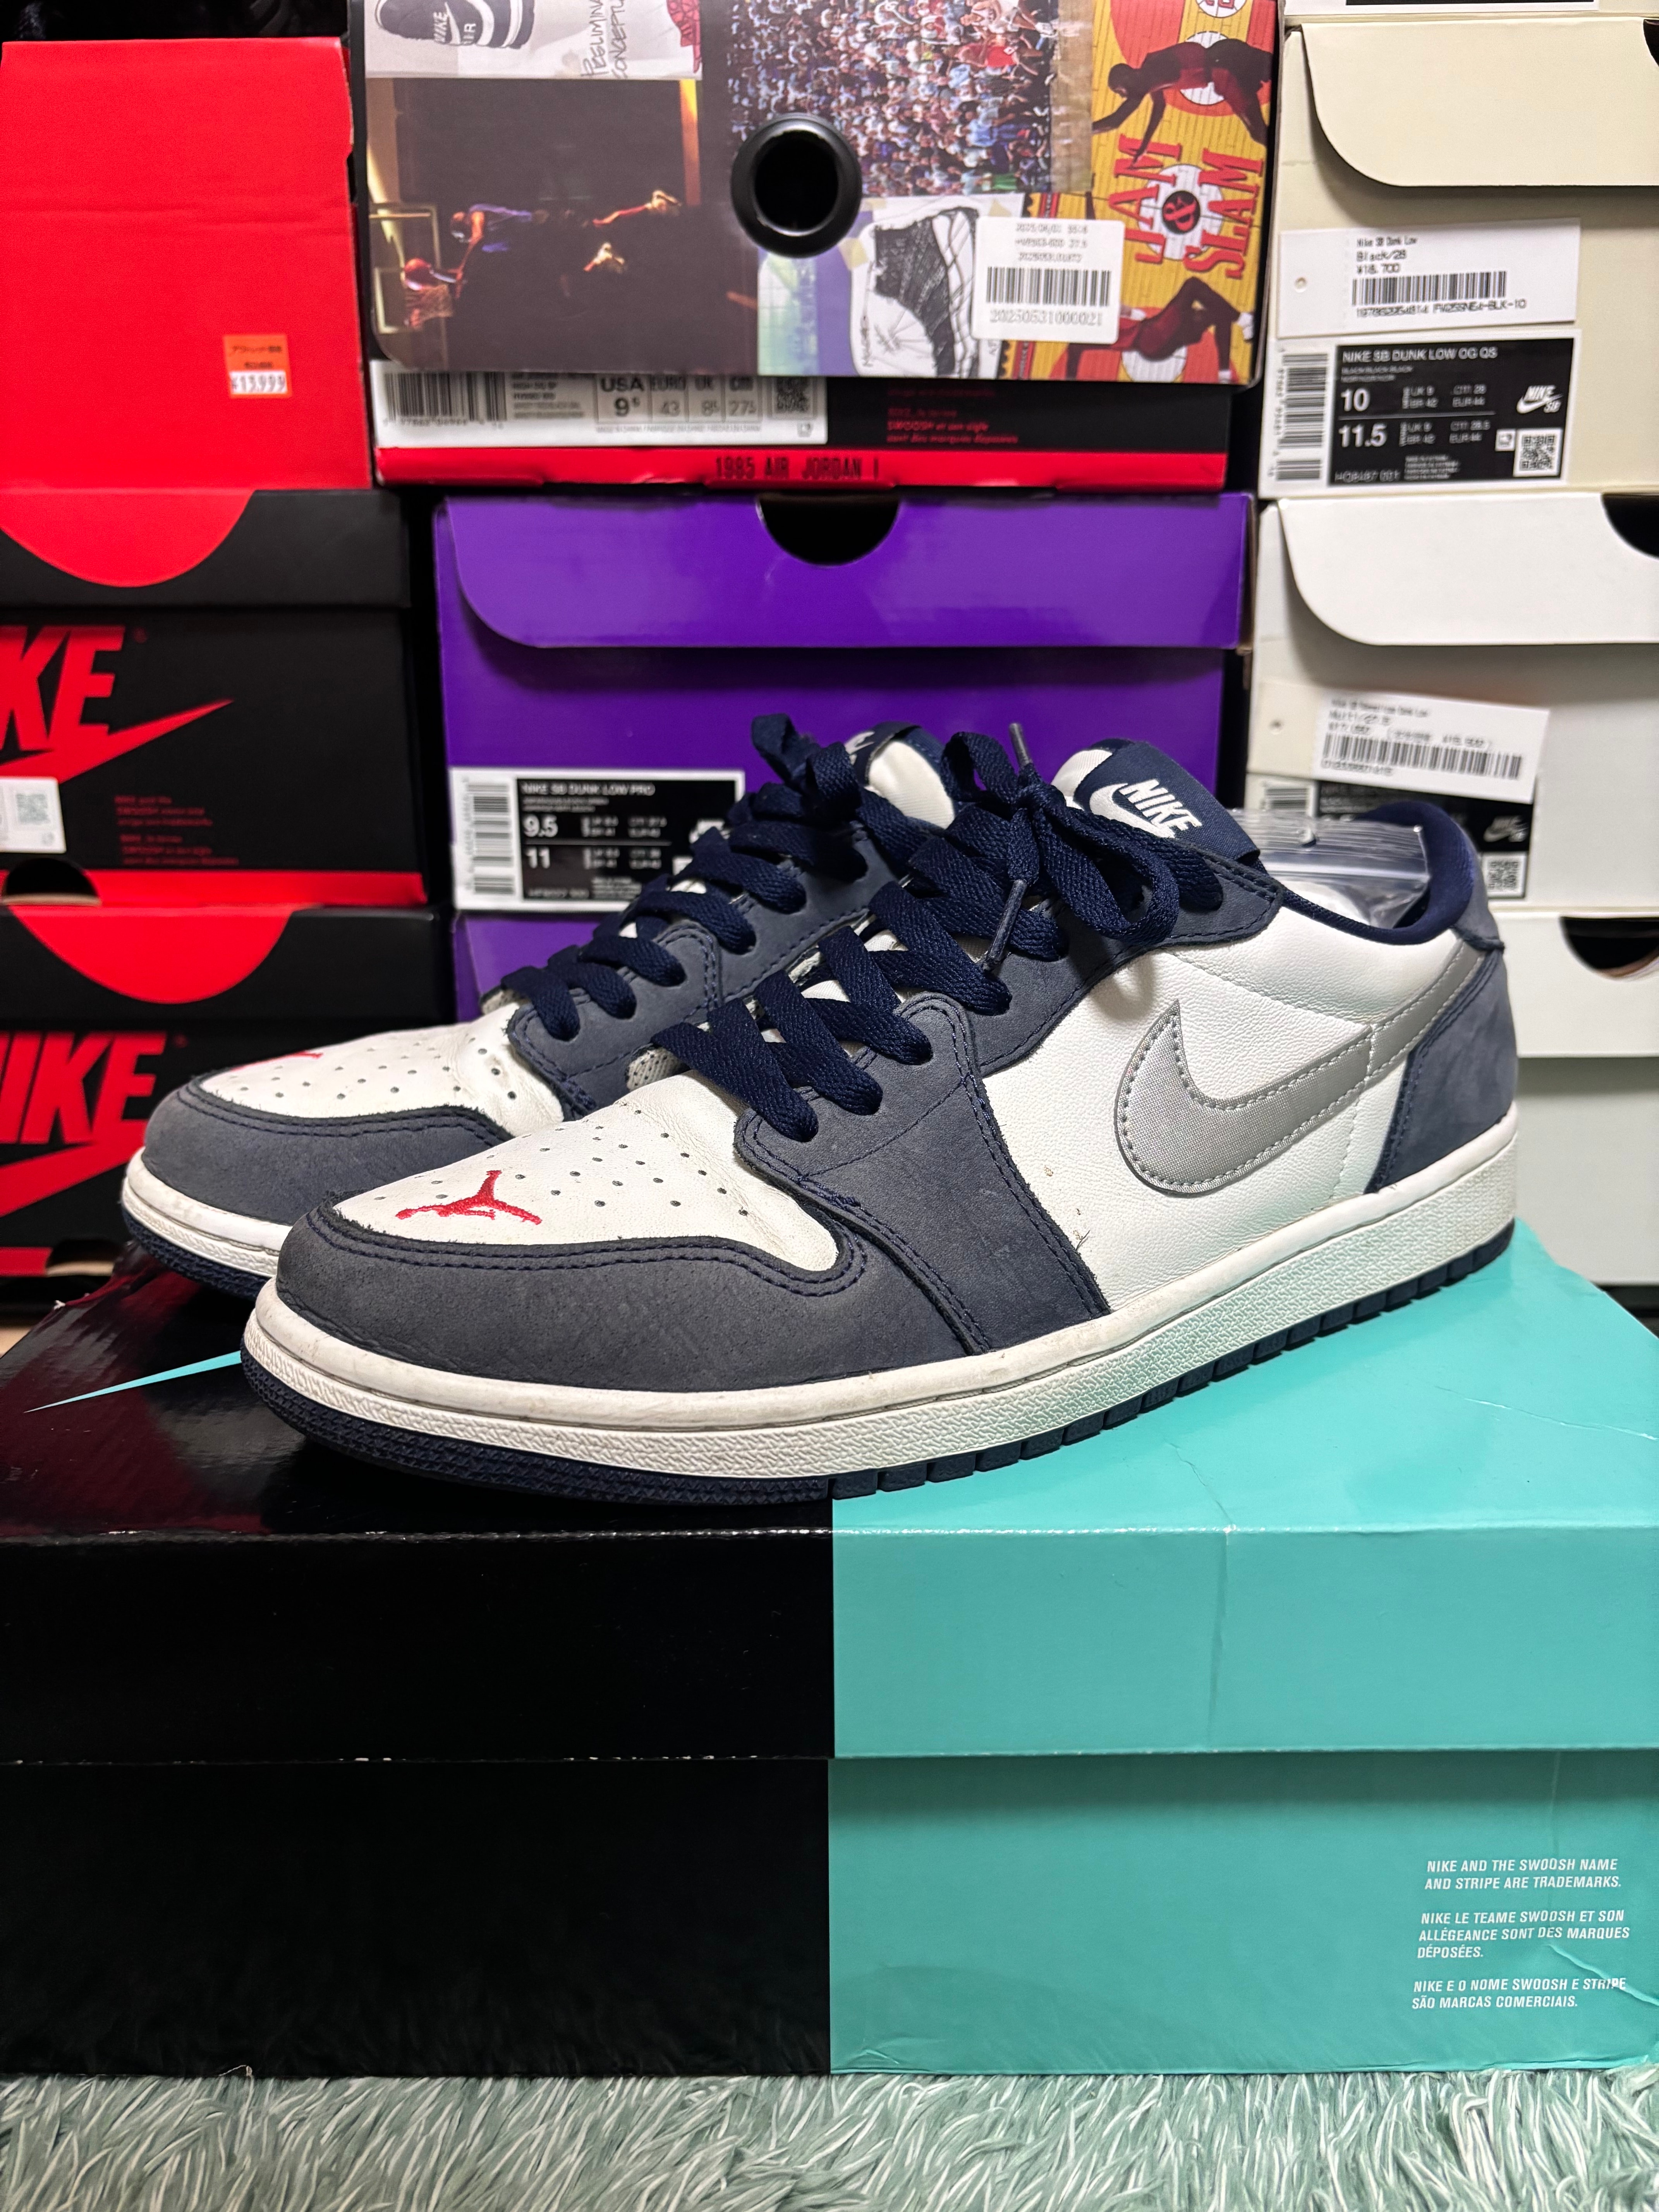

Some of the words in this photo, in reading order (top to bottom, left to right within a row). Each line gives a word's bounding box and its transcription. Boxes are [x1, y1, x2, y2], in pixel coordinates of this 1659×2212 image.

[1342, 349, 1371, 363] NIKE
[1373, 349, 1391, 362] SB
[1392, 348, 1427, 361] DUNK
[1428, 347, 1457, 361] LOW
[1479, 346, 1498, 359] QS
[601, 377, 644, 392] USA
[1341, 388, 1370, 412] 10
[1523, 385, 1556, 402] NIKE
[1338, 423, 1388, 448] 11.5
[802, 457, 862, 479] JORDAN
[1118, 779, 1202, 834] NIKE
[523, 814, 558, 837] 9.5
[526, 847, 550, 869] 11
[0, 1031, 167, 1145] IKE
[1427, 1860, 1457, 1872] NIKE
[1461, 1860, 1487, 1872] AND
[1492, 1860, 1515, 1871] THE
[1519, 1858, 1575, 1871] SWOOSH
[1580, 1859, 1618, 1870] NAME
[1425, 1878, 1451, 1889] AND
[1455, 1877, 1500, 1889] STRIPE
[1504, 1877, 1529, 1888] ARE
[1533, 1876, 1621, 1888] TRADEMARKS.
[1421, 1913, 1451, 1924] NIKE
[1455, 1912, 1469, 1923] LE
[1474, 1911, 1516, 1923] TEAME
[1520, 1910, 1575, 1922] SWOOSH
[1580, 1911, 1595, 1922] ET
[1598, 1910, 1625, 1922] SON
[1419, 1927, 1498, 1941] ALLÉGEANCE
[1501, 1928, 1534, 1940] SONT
[1538, 1927, 1563, 1938] DES
[1567, 1927, 1630, 1939] MARQUES
[1417, 1944, 1484, 1958] DÉPOSÉES.
[1413, 1980, 1443, 1992] NIKE
[1447, 1980, 1455, 1991] E
[1458, 1980, 1467, 1991] O
[1471, 1978, 1509, 1990] NOME
[1512, 1978, 1568, 1990] SWOOSH
[1571, 1978, 1580, 1990] E
[1583, 1978, 1626, 1990] STRIPE
[1412, 1995, 1435, 2009] SÃO
[1439, 1996, 1492, 2008] MARCAS
[1496, 1996, 1578, 2008] COMERCIAIS.
